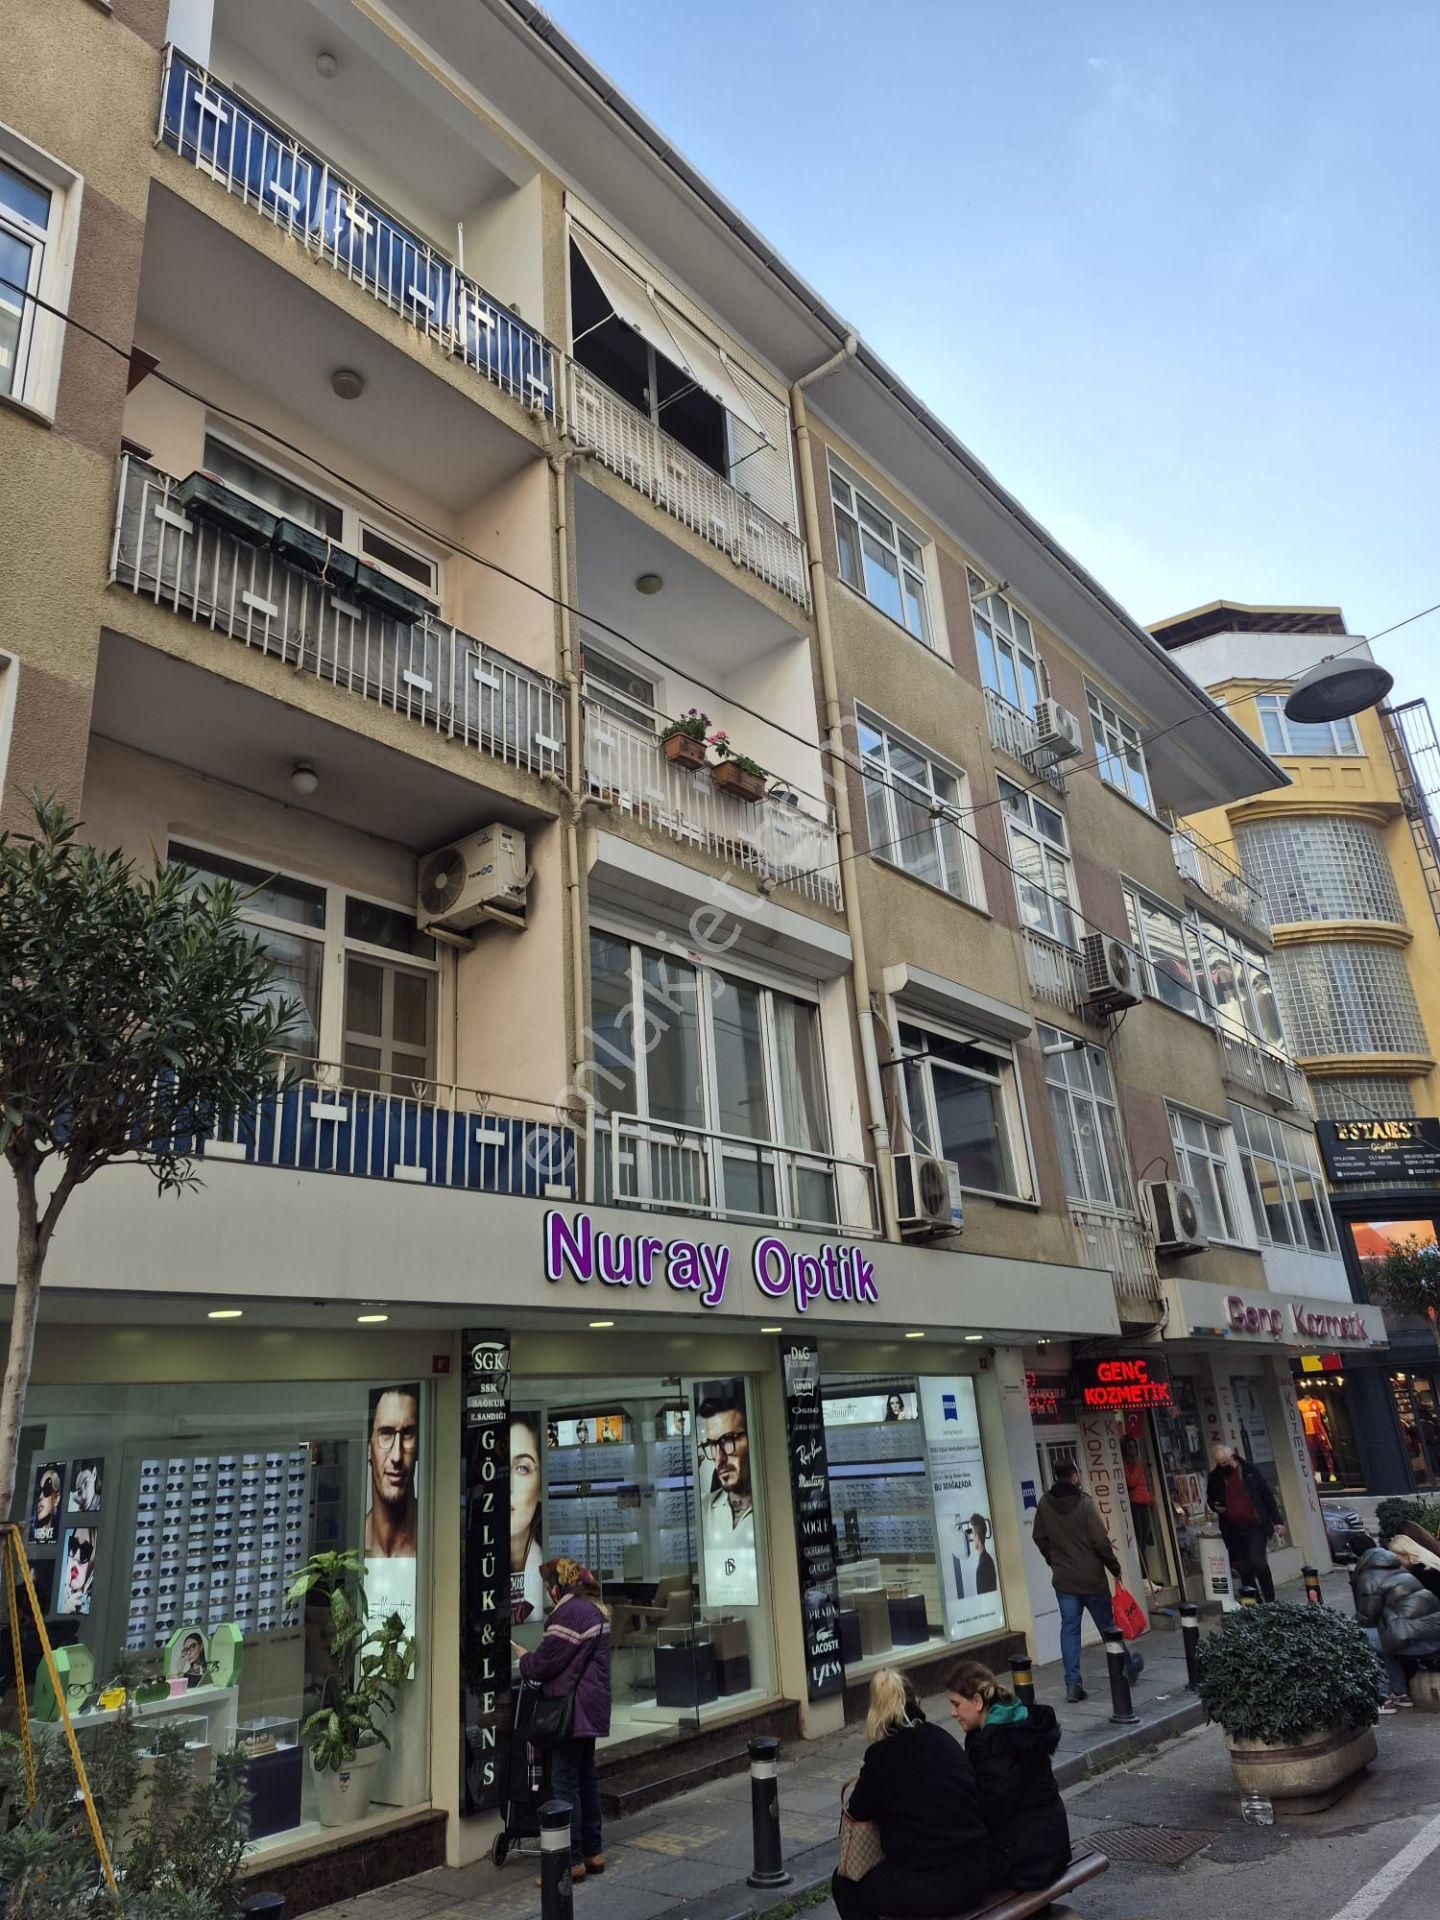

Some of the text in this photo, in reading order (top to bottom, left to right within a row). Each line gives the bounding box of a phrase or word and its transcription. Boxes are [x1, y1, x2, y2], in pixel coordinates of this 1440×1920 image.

[544, 1209, 879, 1312] Nuray Optik
[1224, 1295, 1368, 1341] Genç Kozmetik
[474, 1352, 506, 1370] SGK
[791, 1346, 810, 1360] D&G
[1096, 1360, 1148, 1383] GENÇ
[480, 1383, 498, 1393] SSK
[481, 1430, 497, 1611] GÖZLÜK
[809, 1606, 837, 1620] PRADA
[811, 1639, 840, 1655] LACOSTE
[481, 1657, 497, 1786] LENS
